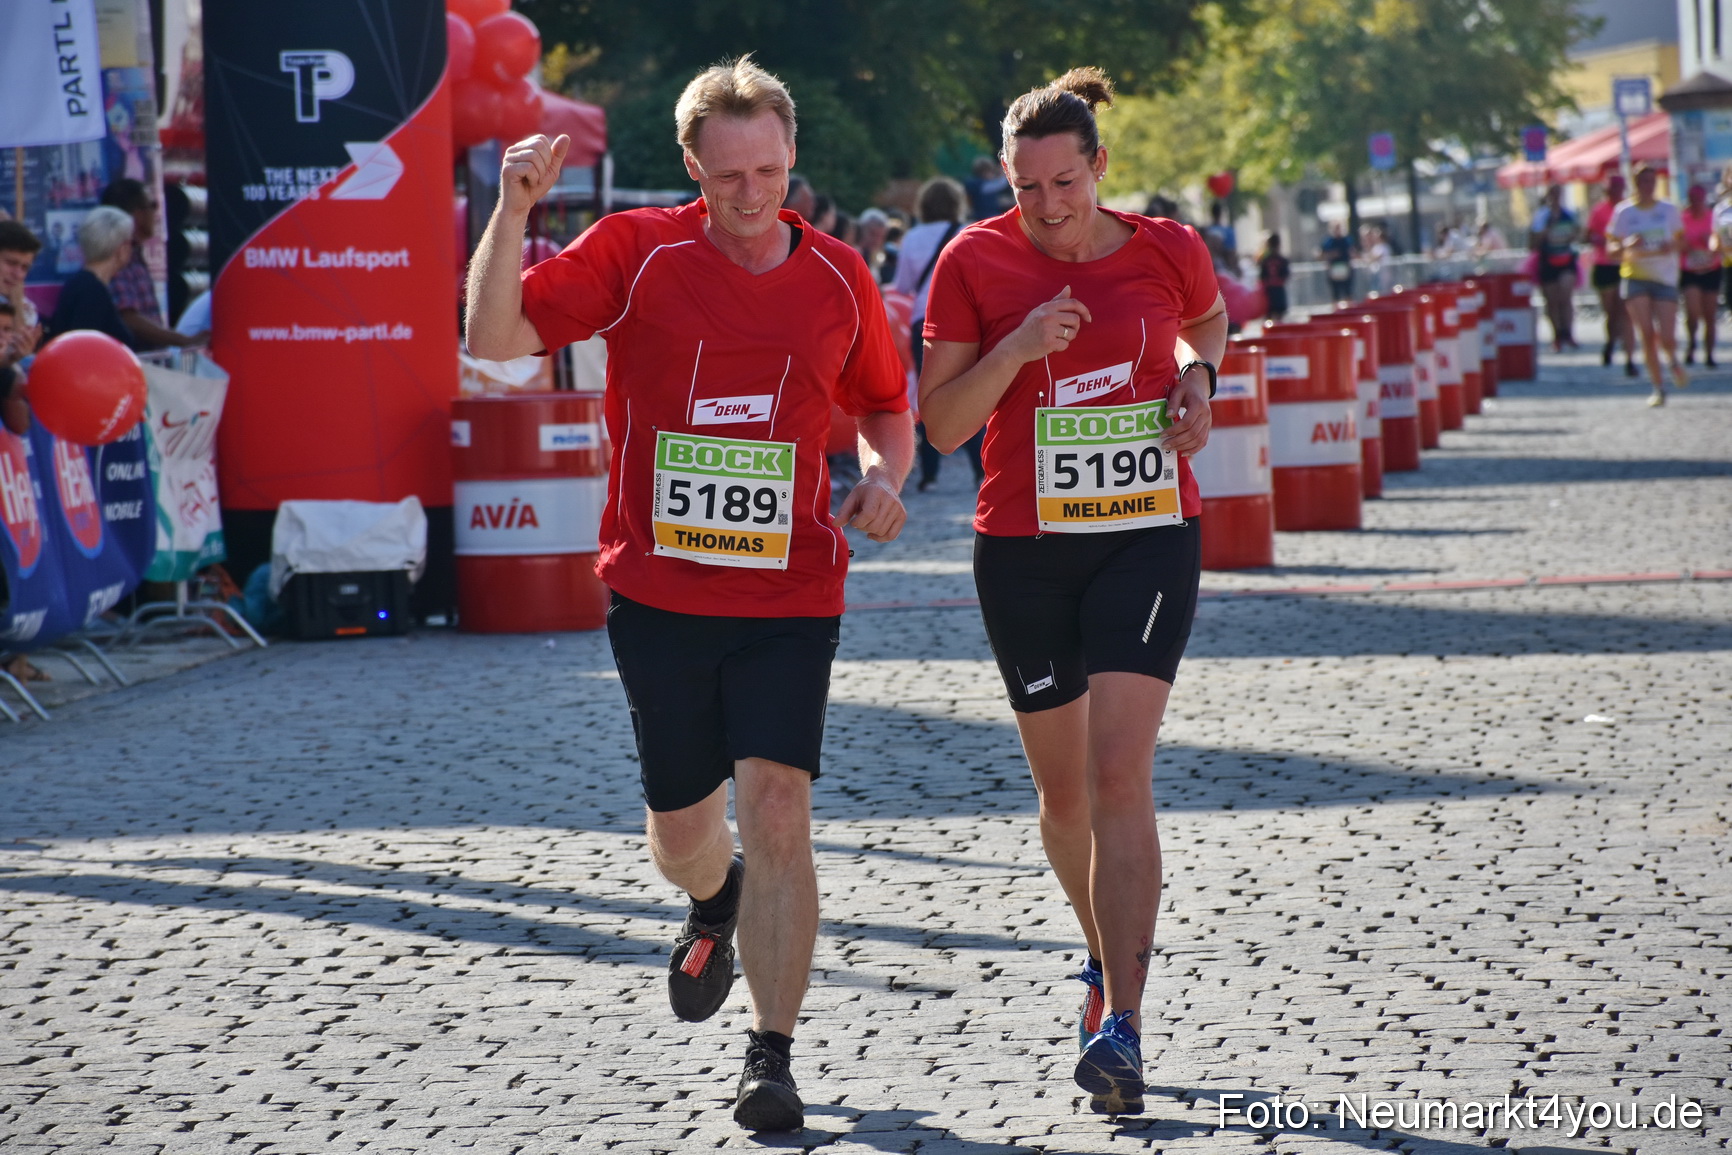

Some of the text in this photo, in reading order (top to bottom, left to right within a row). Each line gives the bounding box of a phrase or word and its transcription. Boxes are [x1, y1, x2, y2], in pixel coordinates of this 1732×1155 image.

[53, 12, 88, 117] PARTL
[264, 167, 339, 185] THE NEXT
[242, 184, 321, 201] 100 YEARS
[244, 246, 410, 271] BMW Laufsport
[248, 322, 413, 343] www.bmw-partl.de
[1076, 374, 1112, 394] DEHN
[714, 403, 751, 417] DEHN
[1048, 408, 1161, 439] BOCK
[667, 440, 781, 475] BOCK
[1054, 446, 1163, 490] 5190
[667, 479, 777, 524] 5189
[780, 490, 788, 499] S
[104, 500, 143, 521] MOBILE
[1063, 496, 1156, 518] MELANIE
[675, 530, 764, 553] THOMAS
